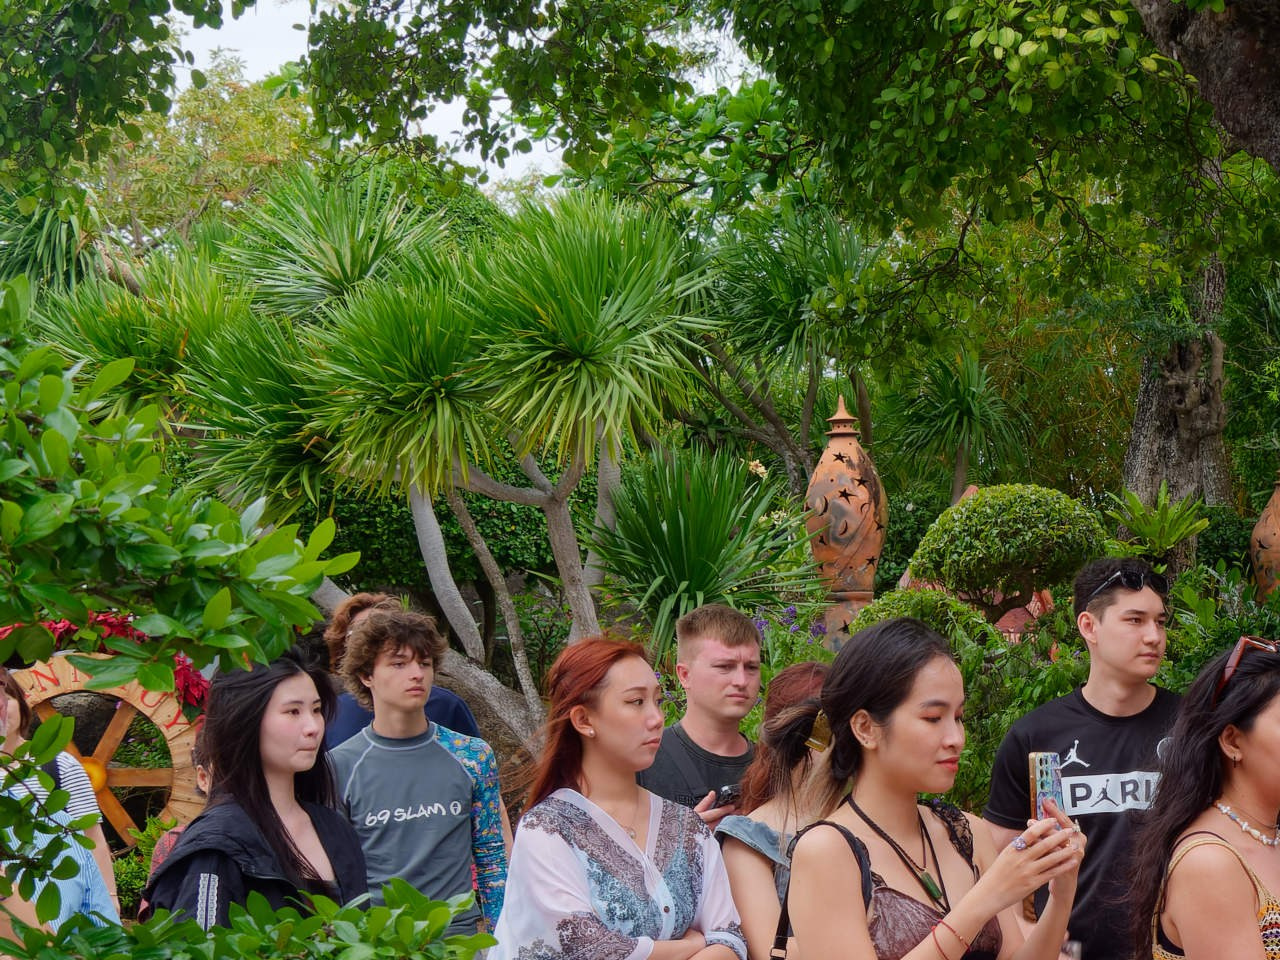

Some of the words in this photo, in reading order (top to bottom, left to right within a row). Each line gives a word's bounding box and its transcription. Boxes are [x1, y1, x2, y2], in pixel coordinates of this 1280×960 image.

[1069, 779, 1150, 808] PARI
[365, 809, 391, 827] 69
[393, 802, 447, 822] SLAM
